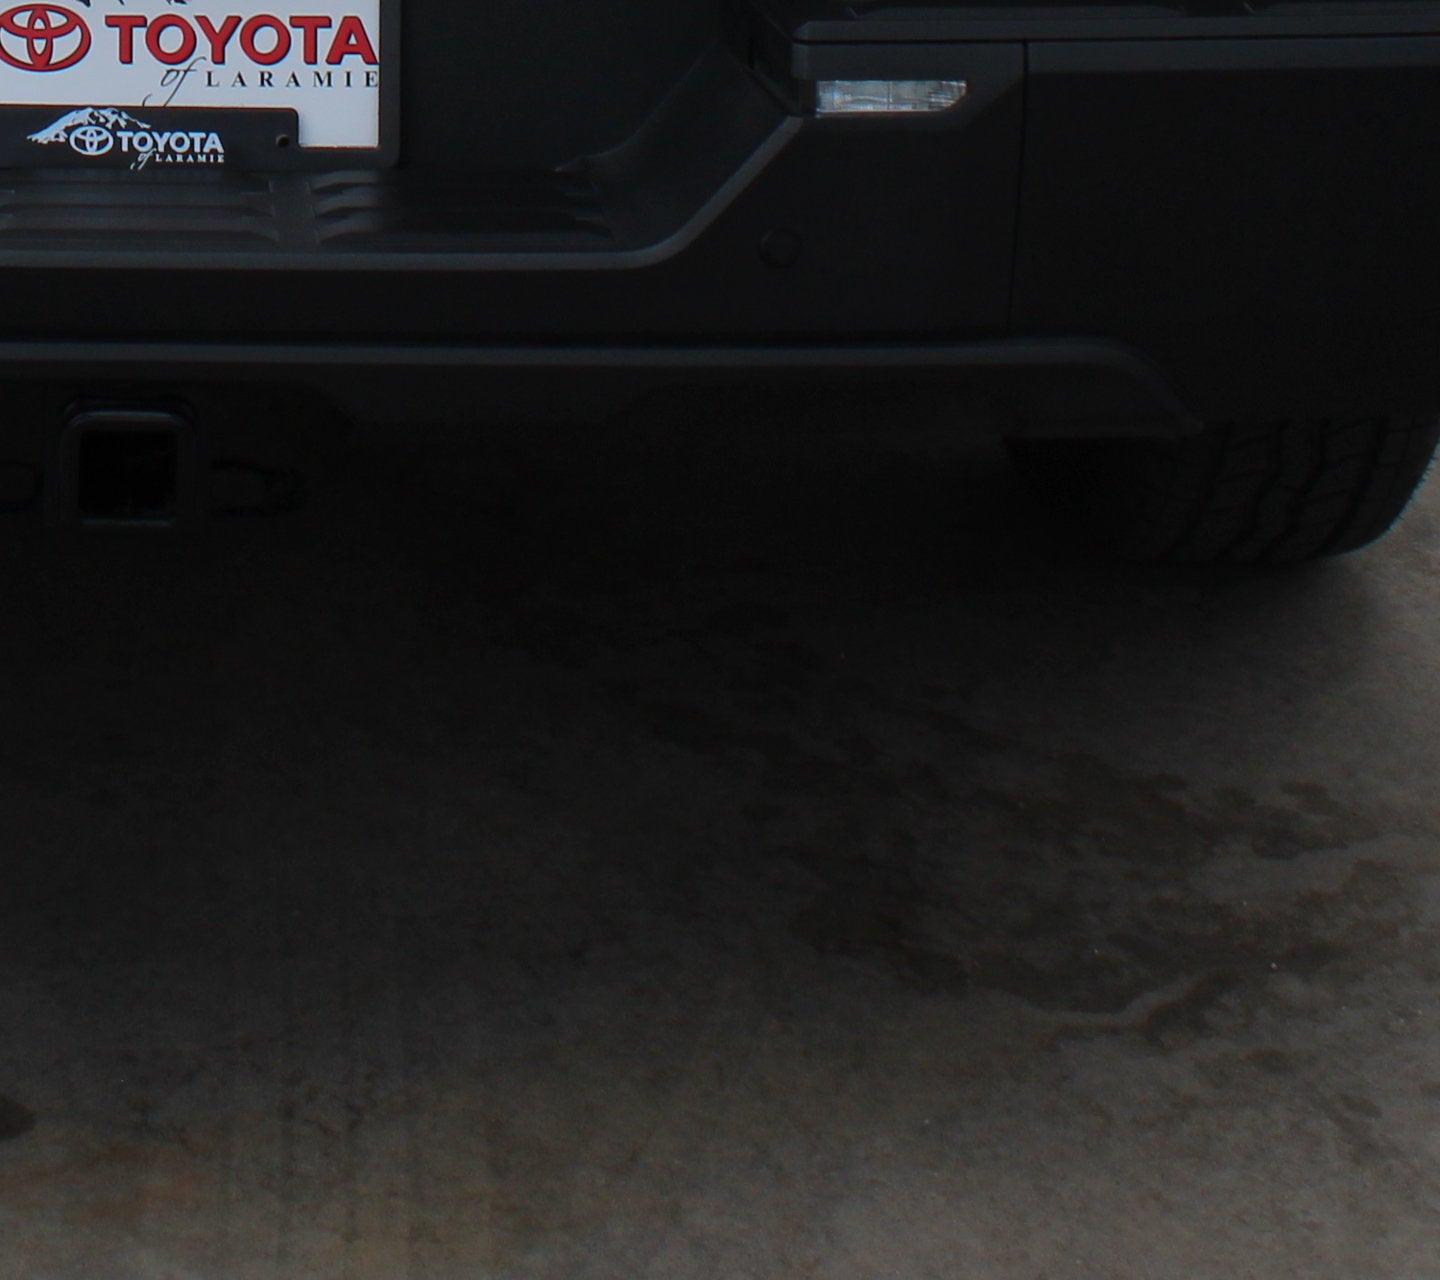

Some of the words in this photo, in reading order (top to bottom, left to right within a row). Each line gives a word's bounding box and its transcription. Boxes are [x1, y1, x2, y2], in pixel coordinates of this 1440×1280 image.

[104, 14, 379, 66] TOYOTA
[142, 56, 207, 108] of
[206, 70, 378, 88] LARAMIE
[117, 131, 225, 154] TOYOTA
[130, 148, 156, 170] of
[154, 153, 224, 163] LARAMIE
